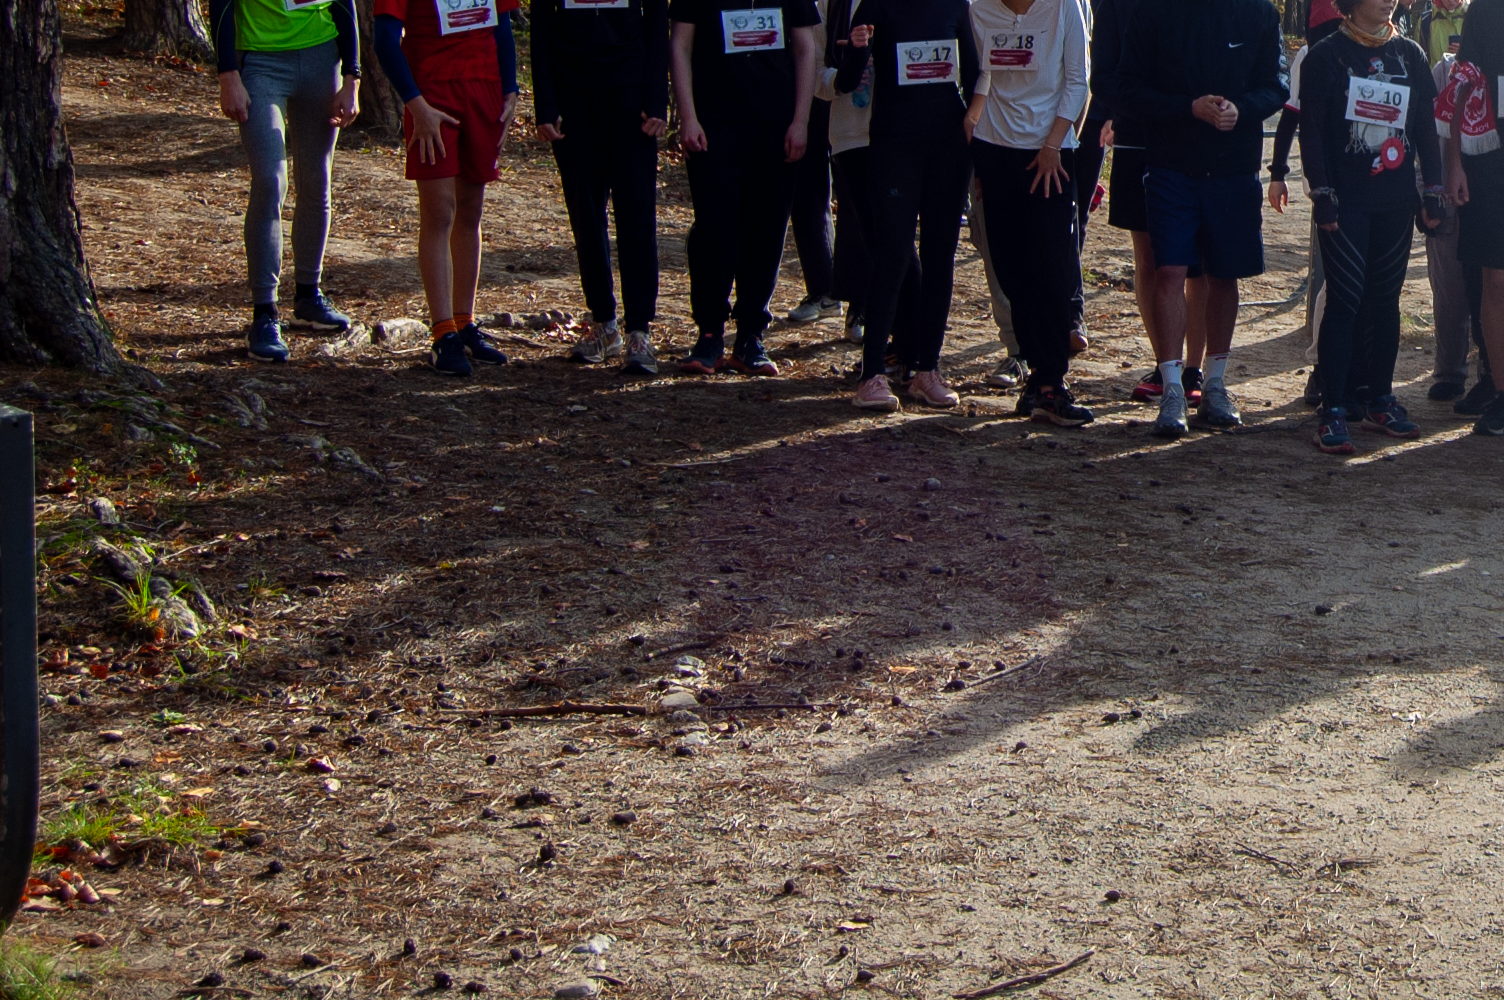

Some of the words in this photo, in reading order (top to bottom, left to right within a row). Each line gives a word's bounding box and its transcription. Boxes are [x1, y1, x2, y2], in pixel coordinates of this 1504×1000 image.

[757, 16, 776, 29] 31
[1016, 35, 1033, 49] 18
[932, 47, 950, 61] 17
[1384, 91, 1402, 106] 10
